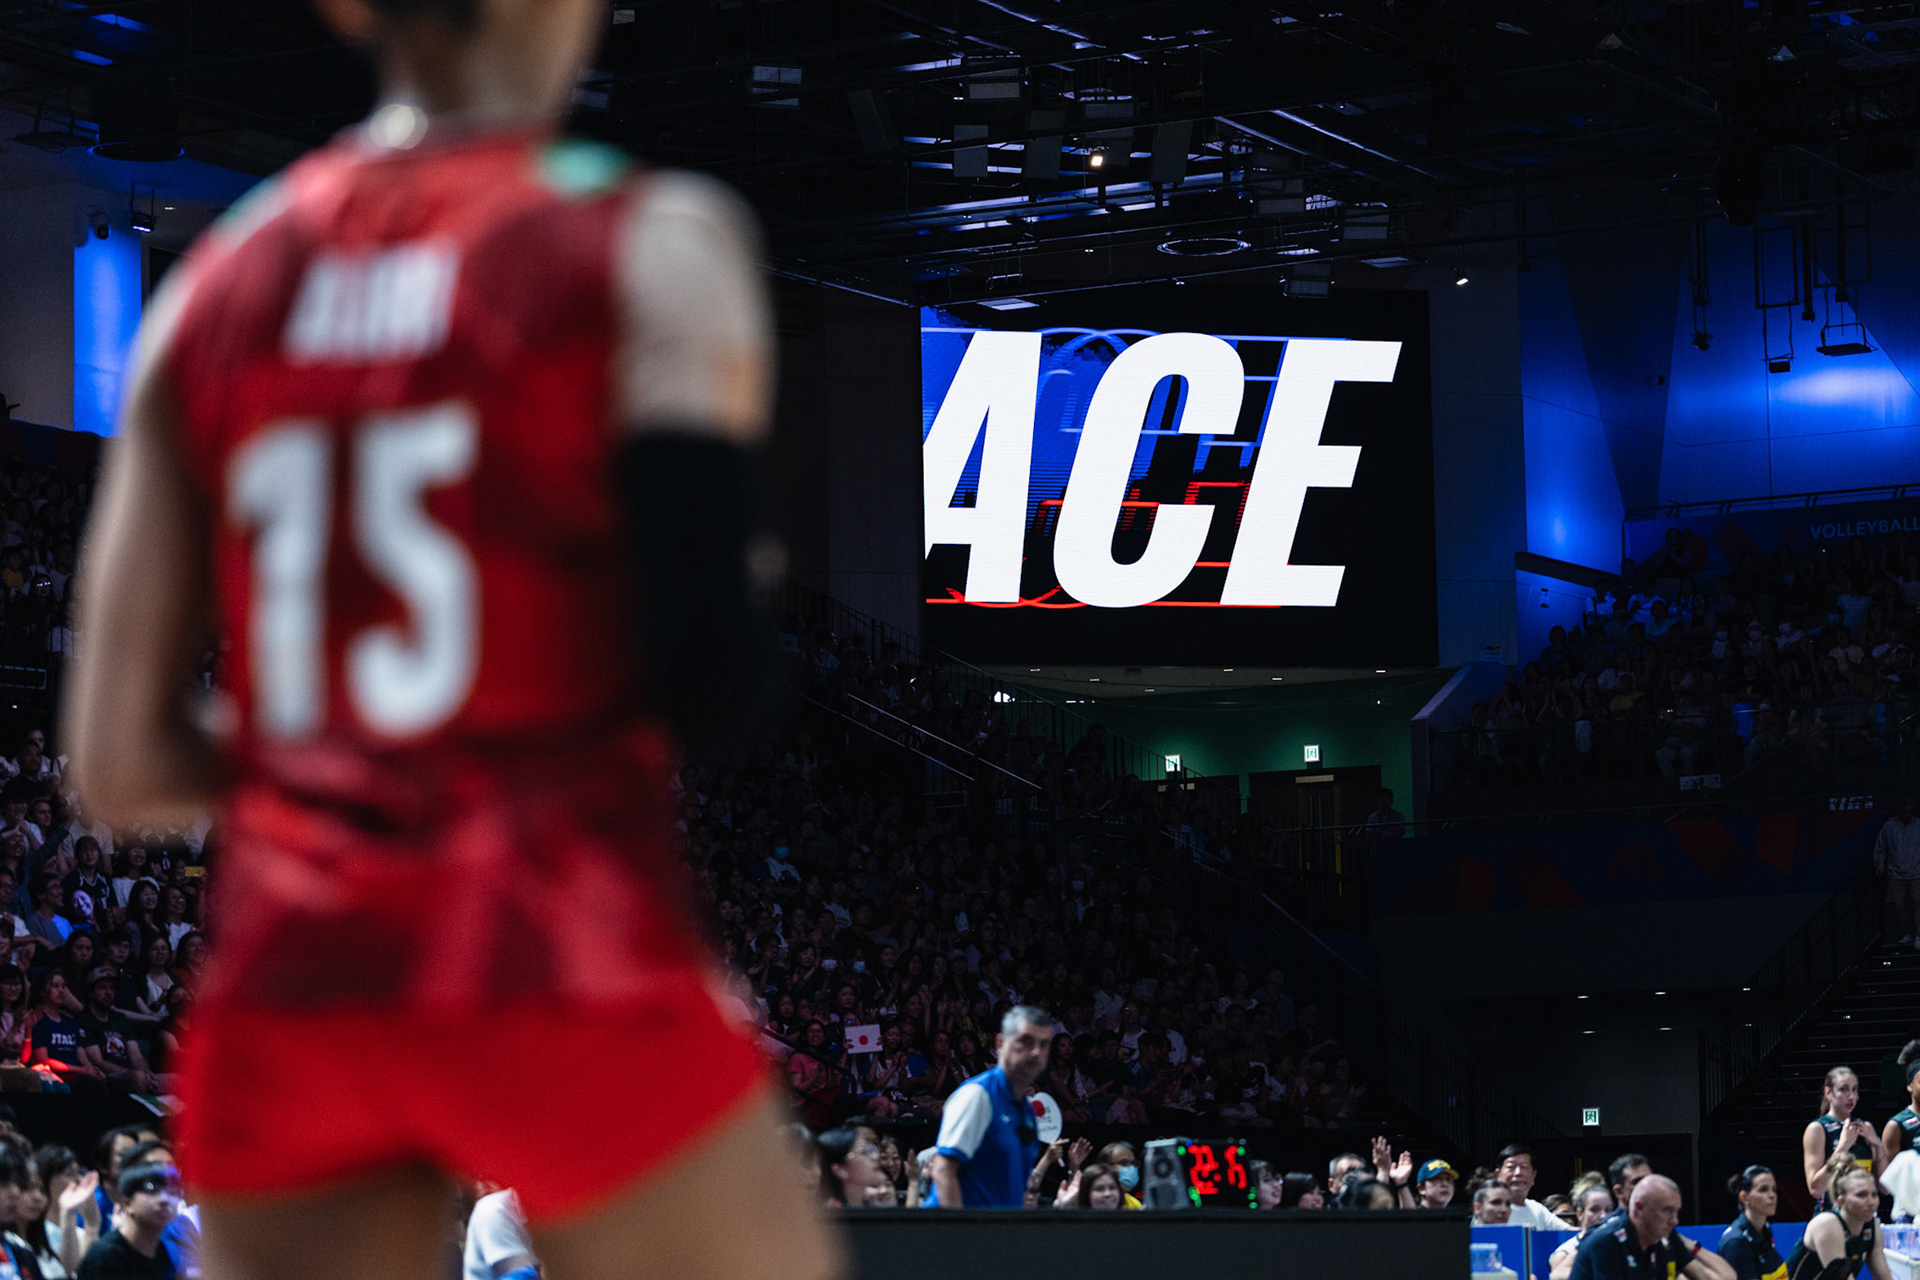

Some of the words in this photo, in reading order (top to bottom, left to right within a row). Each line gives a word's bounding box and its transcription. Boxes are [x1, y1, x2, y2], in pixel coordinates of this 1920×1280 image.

[922, 330, 1402, 607] ACE
[1809, 516, 1920, 540] VOLLEYBALL
[227, 402, 480, 741] 15
[1604, 835, 1664, 882] VNL
[51, 1032, 76, 1046] ITAL
